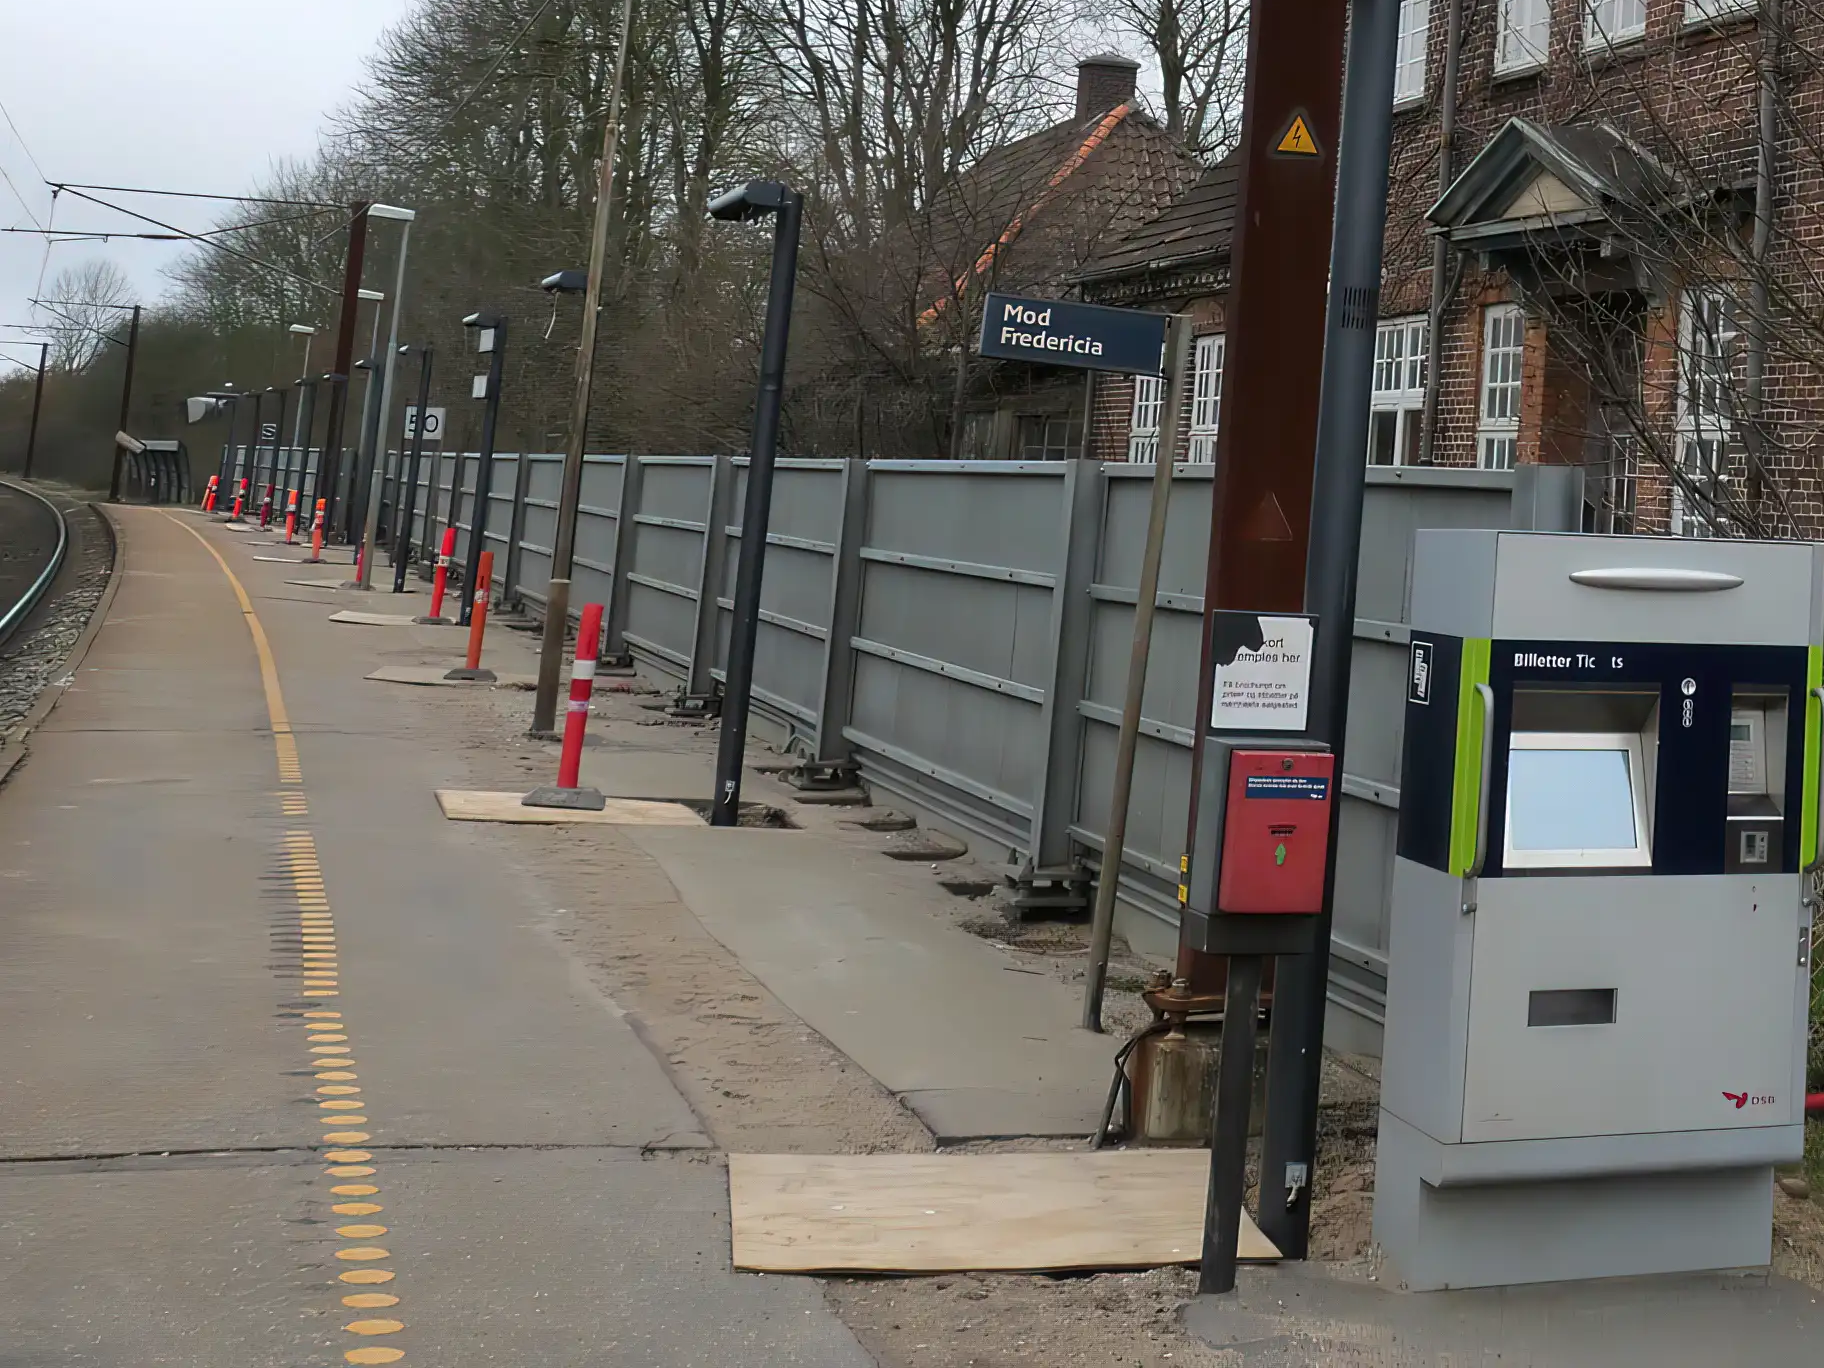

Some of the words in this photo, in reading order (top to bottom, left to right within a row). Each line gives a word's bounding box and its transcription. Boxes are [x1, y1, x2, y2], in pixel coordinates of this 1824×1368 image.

[1003, 303, 1051, 327] Mod
[1000, 326, 1104, 356] Fredericia
[1514, 653, 1572, 668] Billetter
[1576, 653, 1624, 669] Ticts
